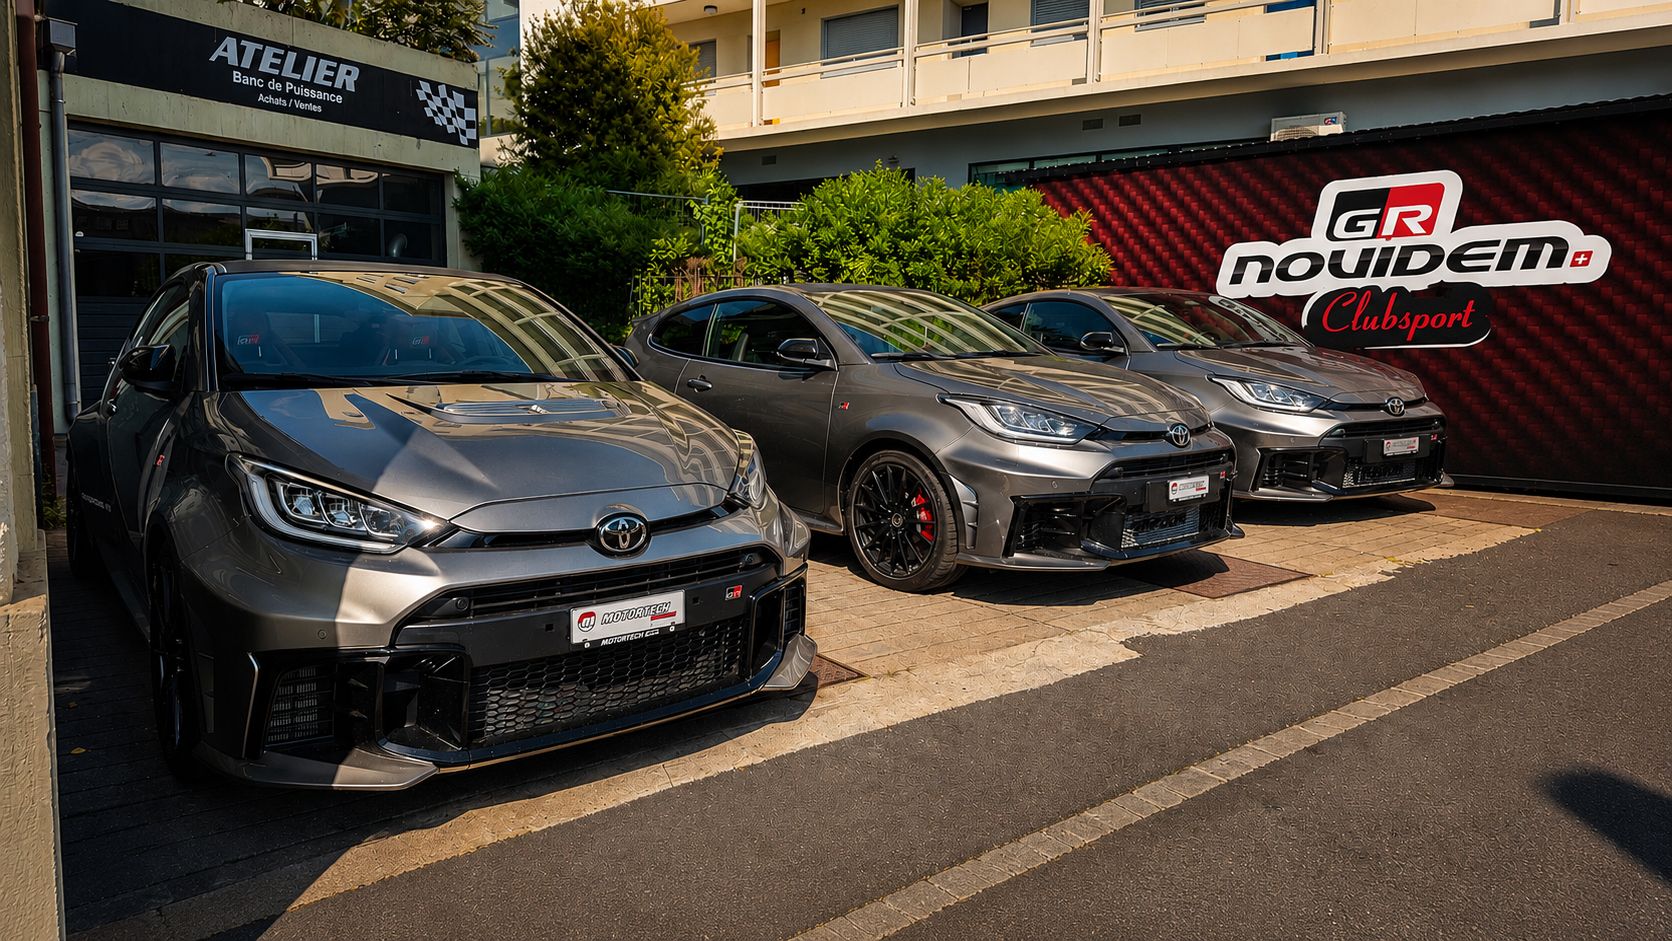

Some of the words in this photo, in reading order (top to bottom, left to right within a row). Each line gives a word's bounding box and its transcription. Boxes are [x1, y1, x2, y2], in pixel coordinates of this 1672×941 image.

[209, 36, 360, 92] ATELIER
[232, 70, 264, 88] Banc
[267, 78, 282, 91] de
[285, 82, 343, 103] Puissance
[258, 93, 287, 107] Achats
[288, 98, 293, 107] /
[294, 99, 322, 112] Ventes
[1331, 203, 1435, 239] GR
[1322, 290, 1475, 341] Clubsport
[601, 602, 671, 625] MOTORTECH
[600, 632, 644, 646] MOTORTECH
